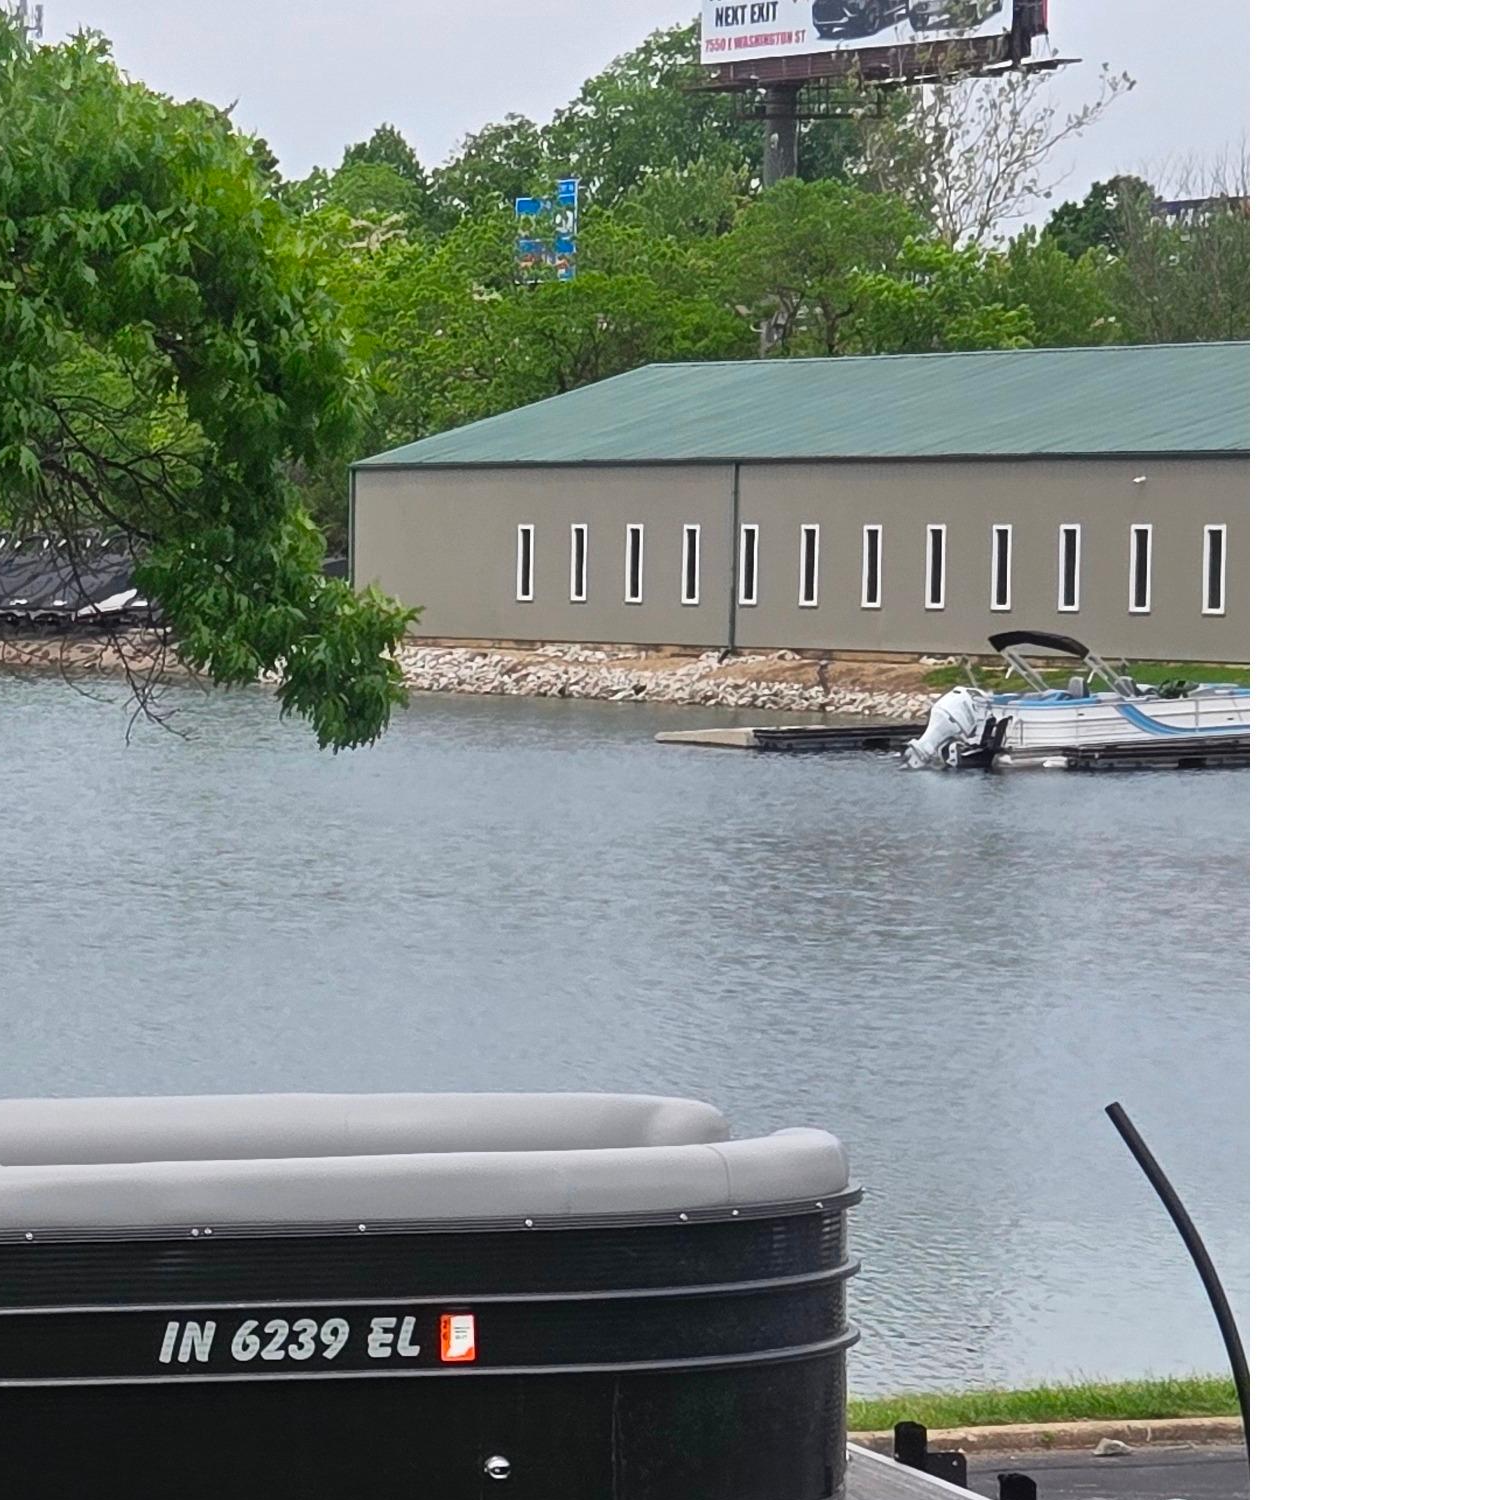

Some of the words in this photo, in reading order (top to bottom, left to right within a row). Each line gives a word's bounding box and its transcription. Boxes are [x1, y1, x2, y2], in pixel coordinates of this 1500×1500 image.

[715, 5, 747, 27] NEXT
[750, 1, 778, 24] EXIT
[734, 30, 793, 49] WASHINGTON
[794, 29, 806, 43] ST
[158, 1320, 216, 1364] IN
[231, 1317, 350, 1362] 6239
[367, 1316, 421, 1359] EL
